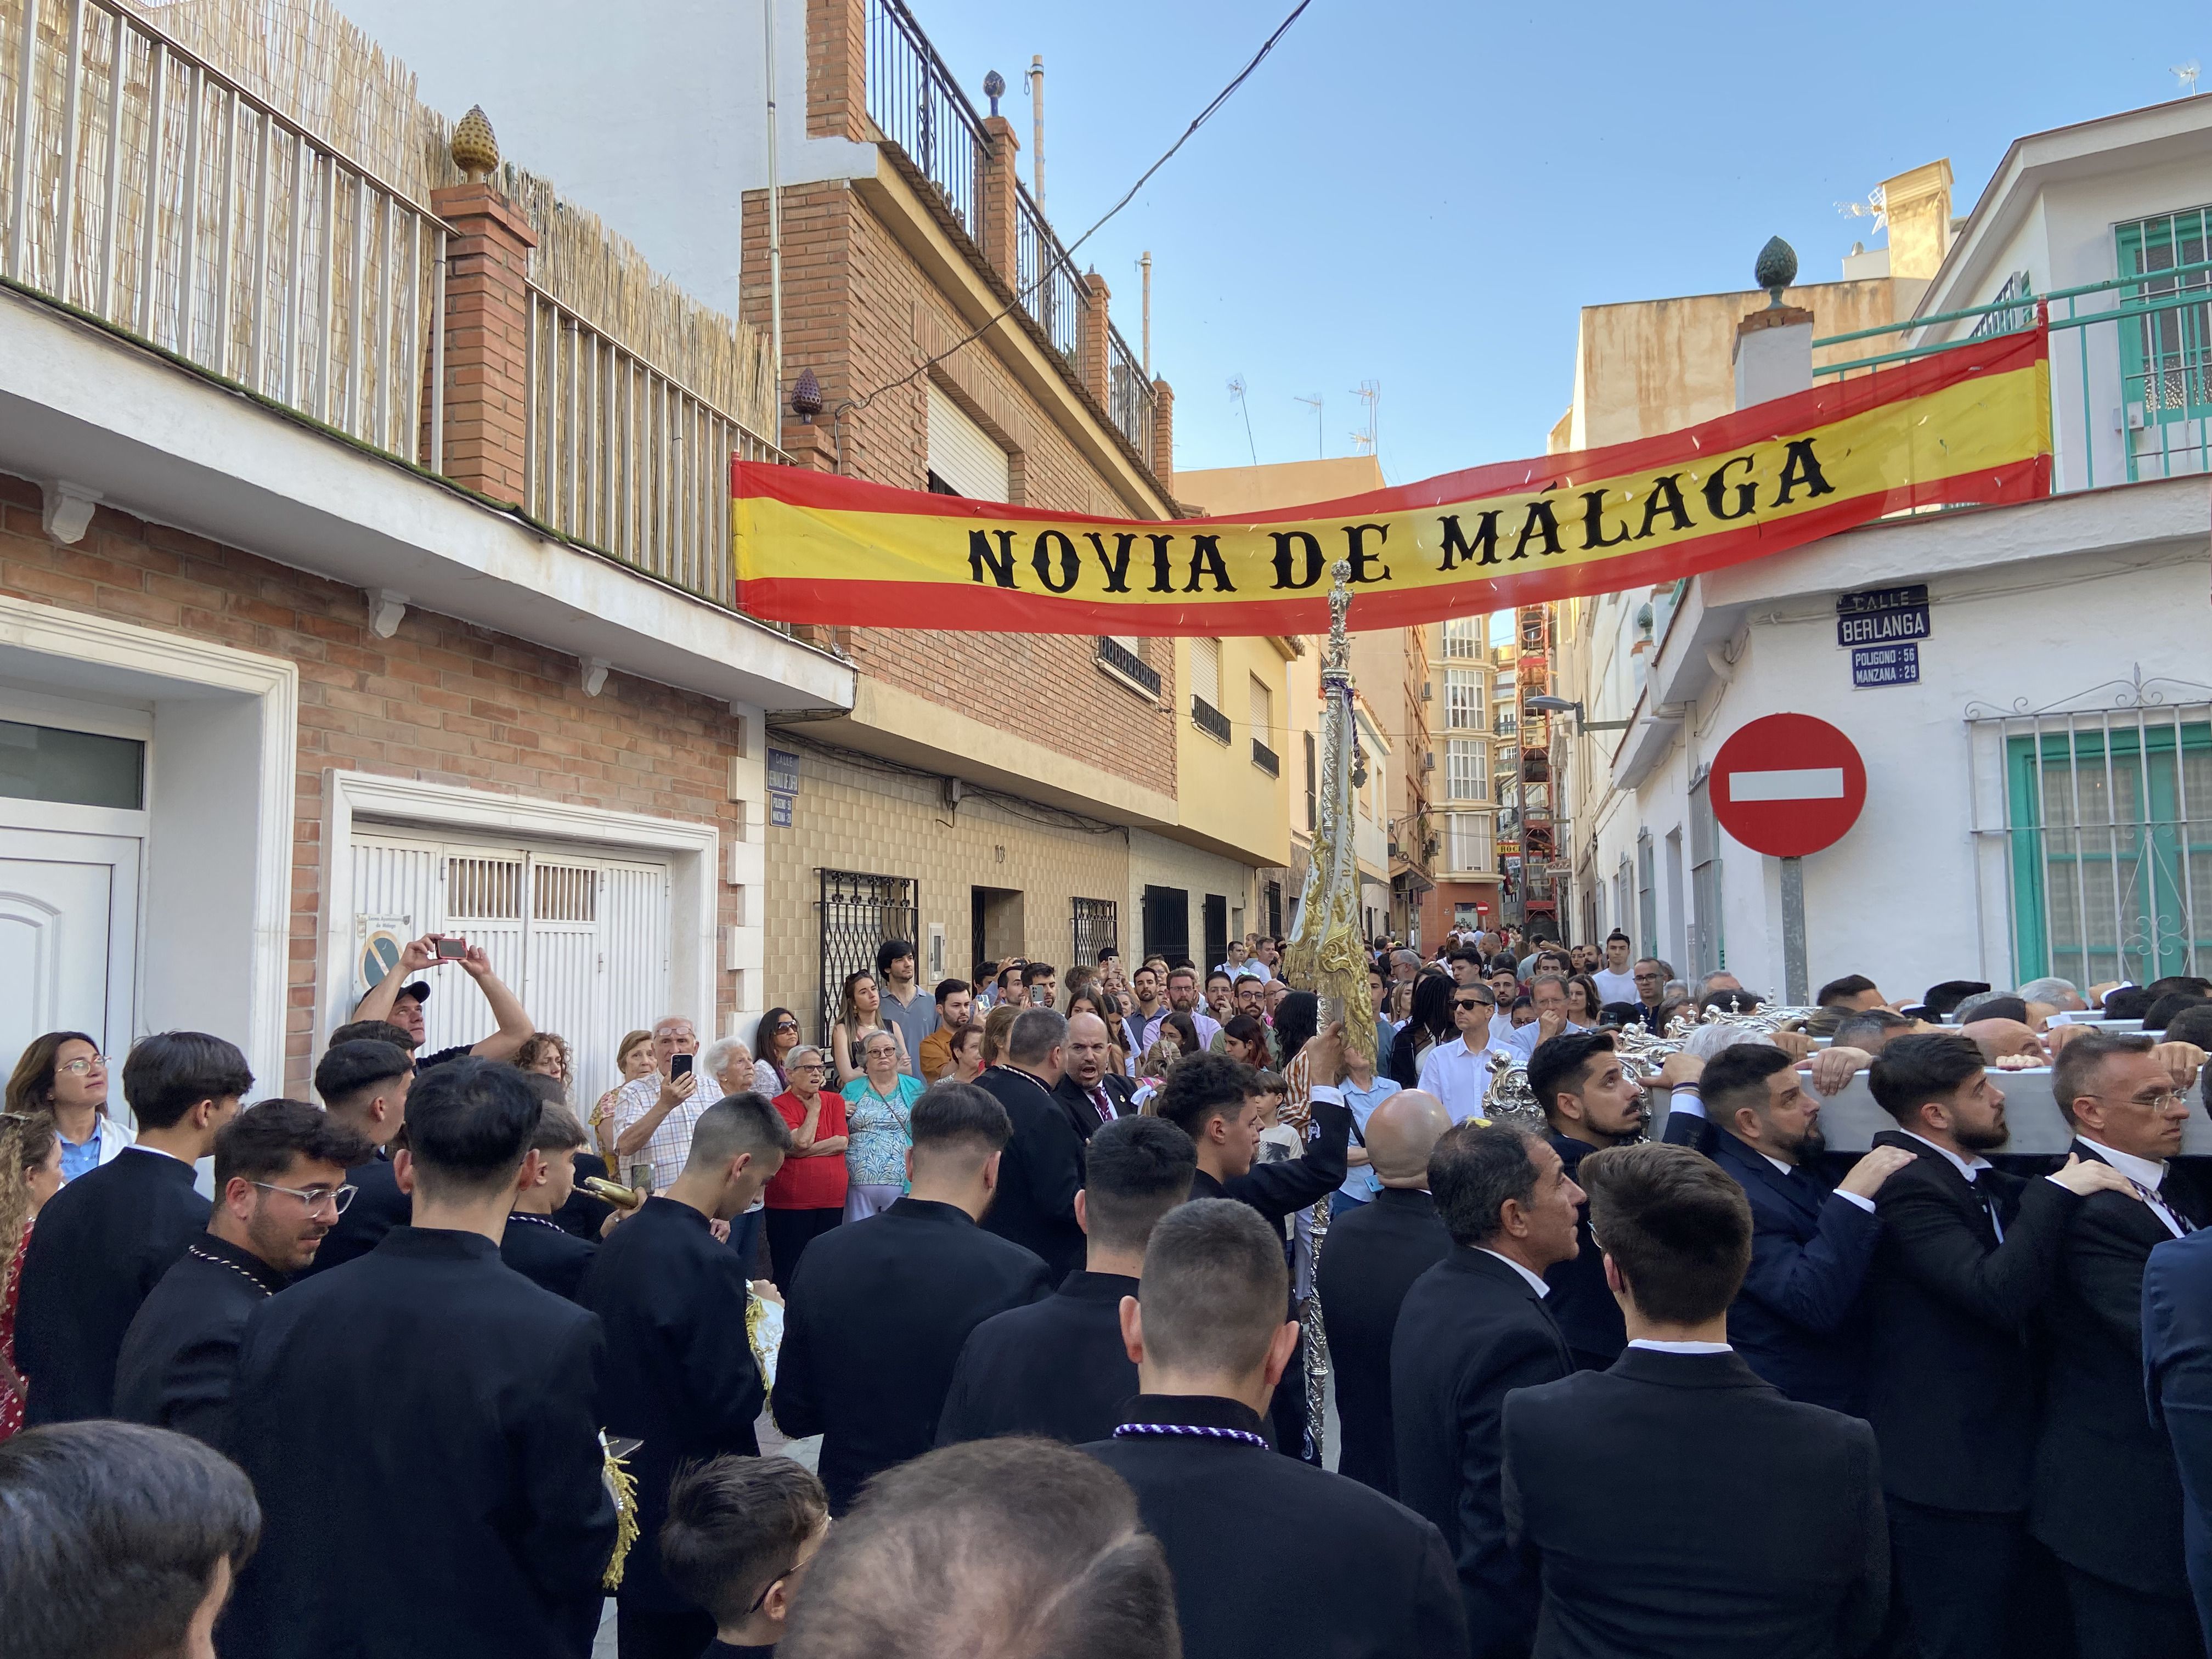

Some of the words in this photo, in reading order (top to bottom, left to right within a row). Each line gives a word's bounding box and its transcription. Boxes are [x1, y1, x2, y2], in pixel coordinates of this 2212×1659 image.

[968, 529, 1238, 594] NOVIA
[1267, 523, 1392, 590] DE
[1436, 438, 1836, 572] MÁLAGA
[1853, 591, 1909, 611] CALLE
[1842, 612, 1925, 642] BERLANGA
[1855, 650, 1897, 667] POLIGONO
[1904, 648, 1915, 662] 56
[1856, 667, 1897, 684] MANZANA
[1904, 664, 1916, 679] 29
[776, 753, 793, 767] CALLE
